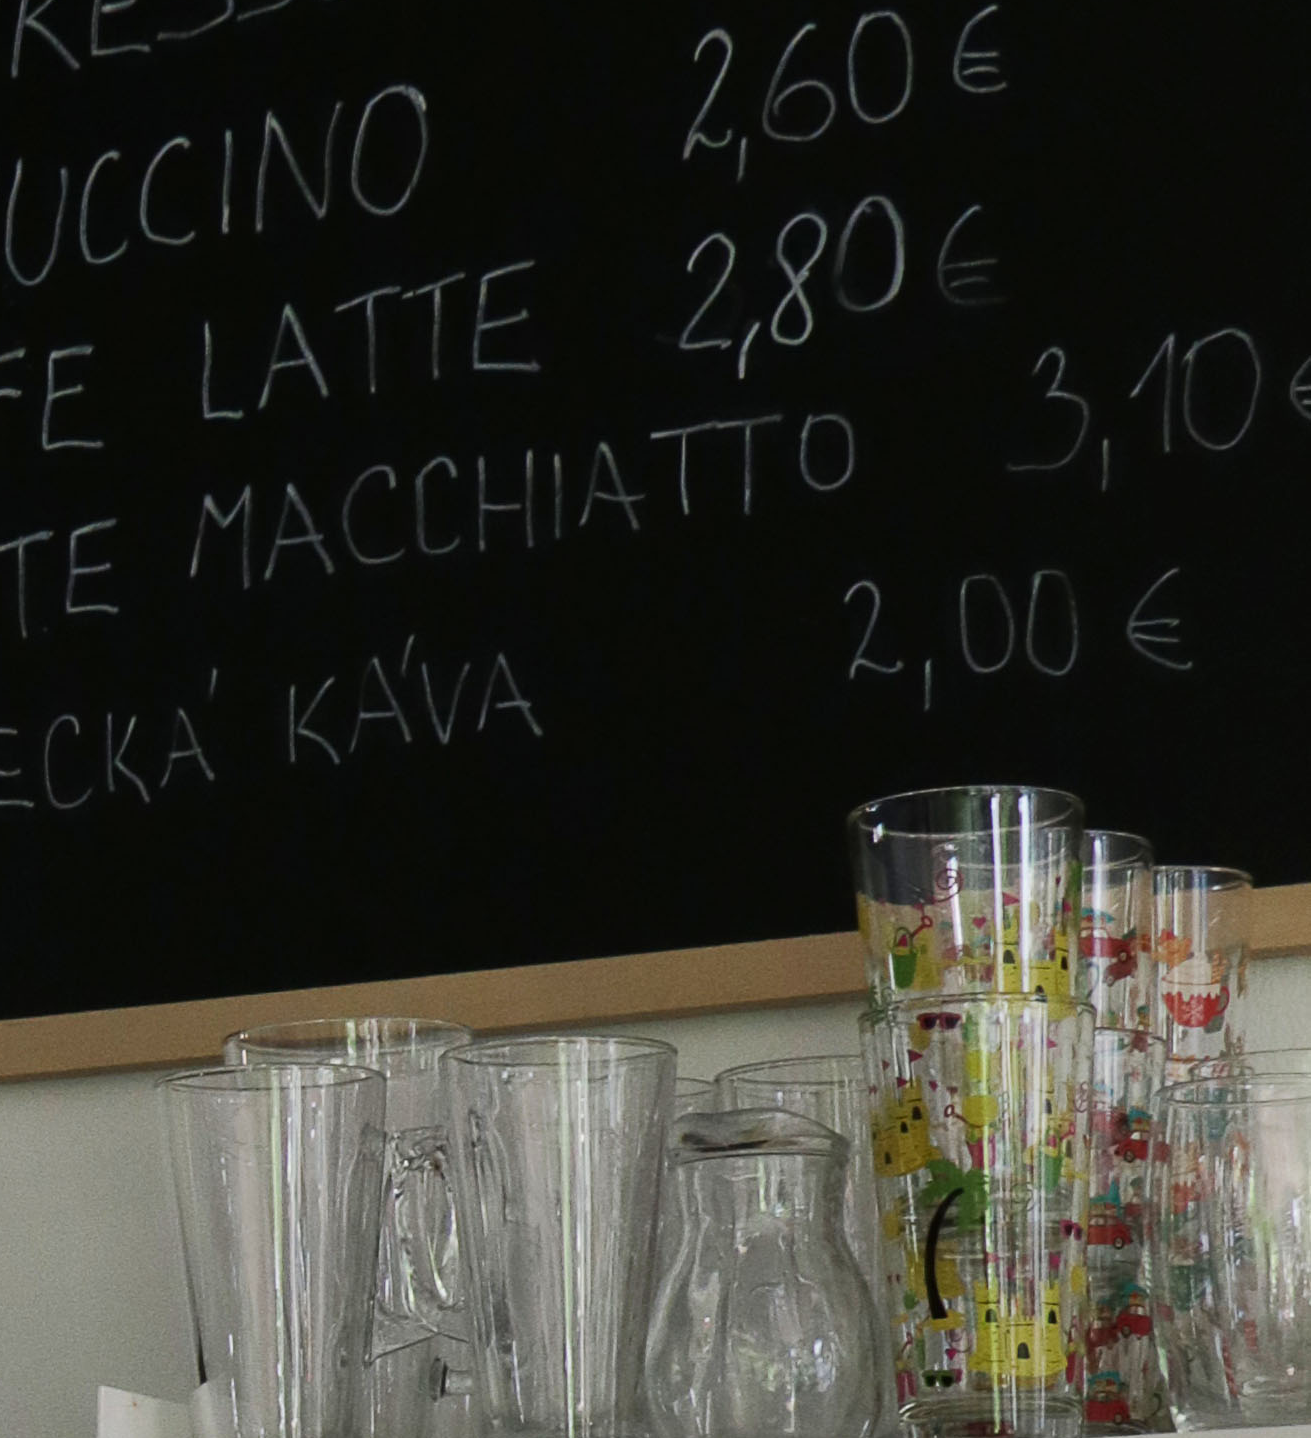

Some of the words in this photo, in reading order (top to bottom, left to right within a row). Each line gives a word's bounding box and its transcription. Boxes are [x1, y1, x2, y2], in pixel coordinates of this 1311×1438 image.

[201, 261, 542, 419] LATTE
[189, 412, 857, 590] MACCHIATTO
[287, 634, 543, 765] KÁVA
